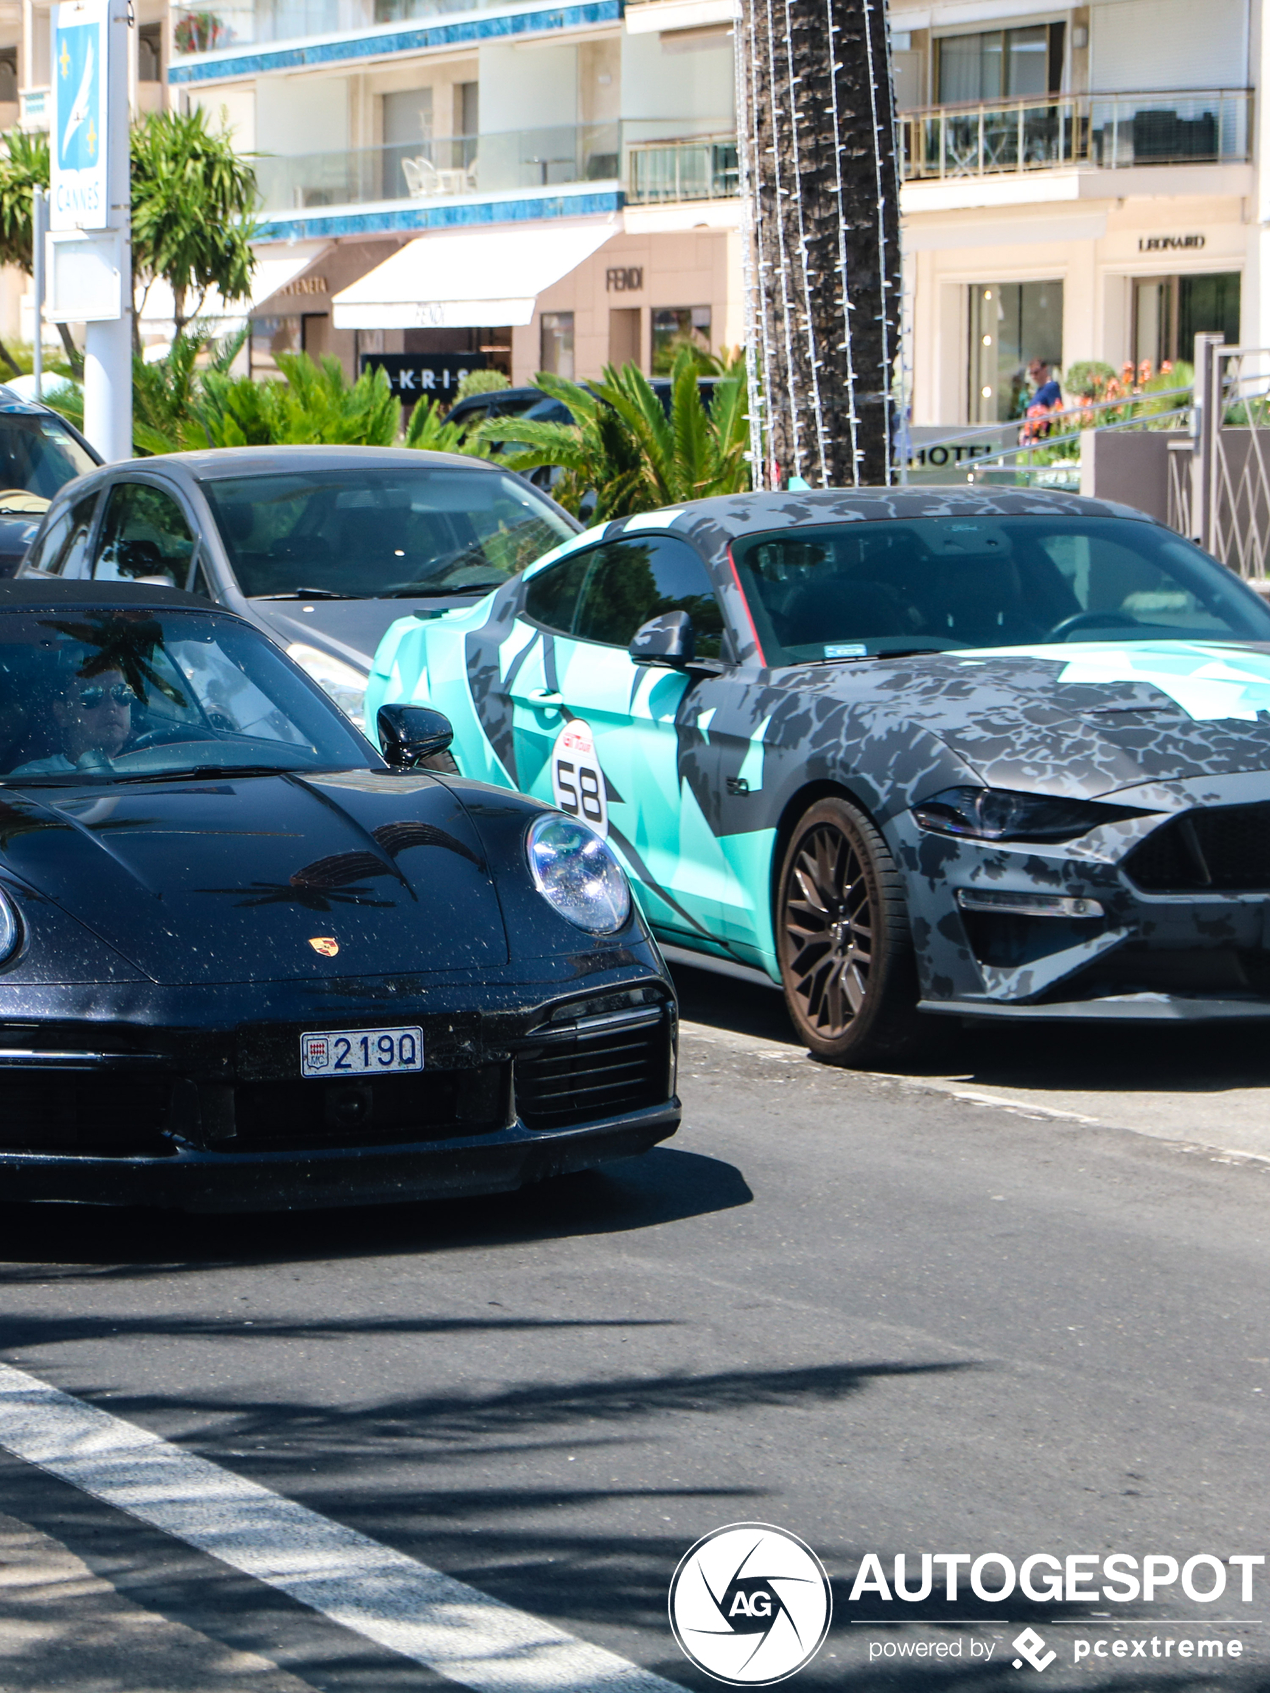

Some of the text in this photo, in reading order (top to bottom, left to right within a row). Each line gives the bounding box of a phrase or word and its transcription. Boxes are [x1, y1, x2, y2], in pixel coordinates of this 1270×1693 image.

[57, 181, 99, 212] CANNES
[1139, 236, 1205, 253] LEONARD
[606, 267, 643, 292] FENDI
[557, 760, 603, 823] 58
